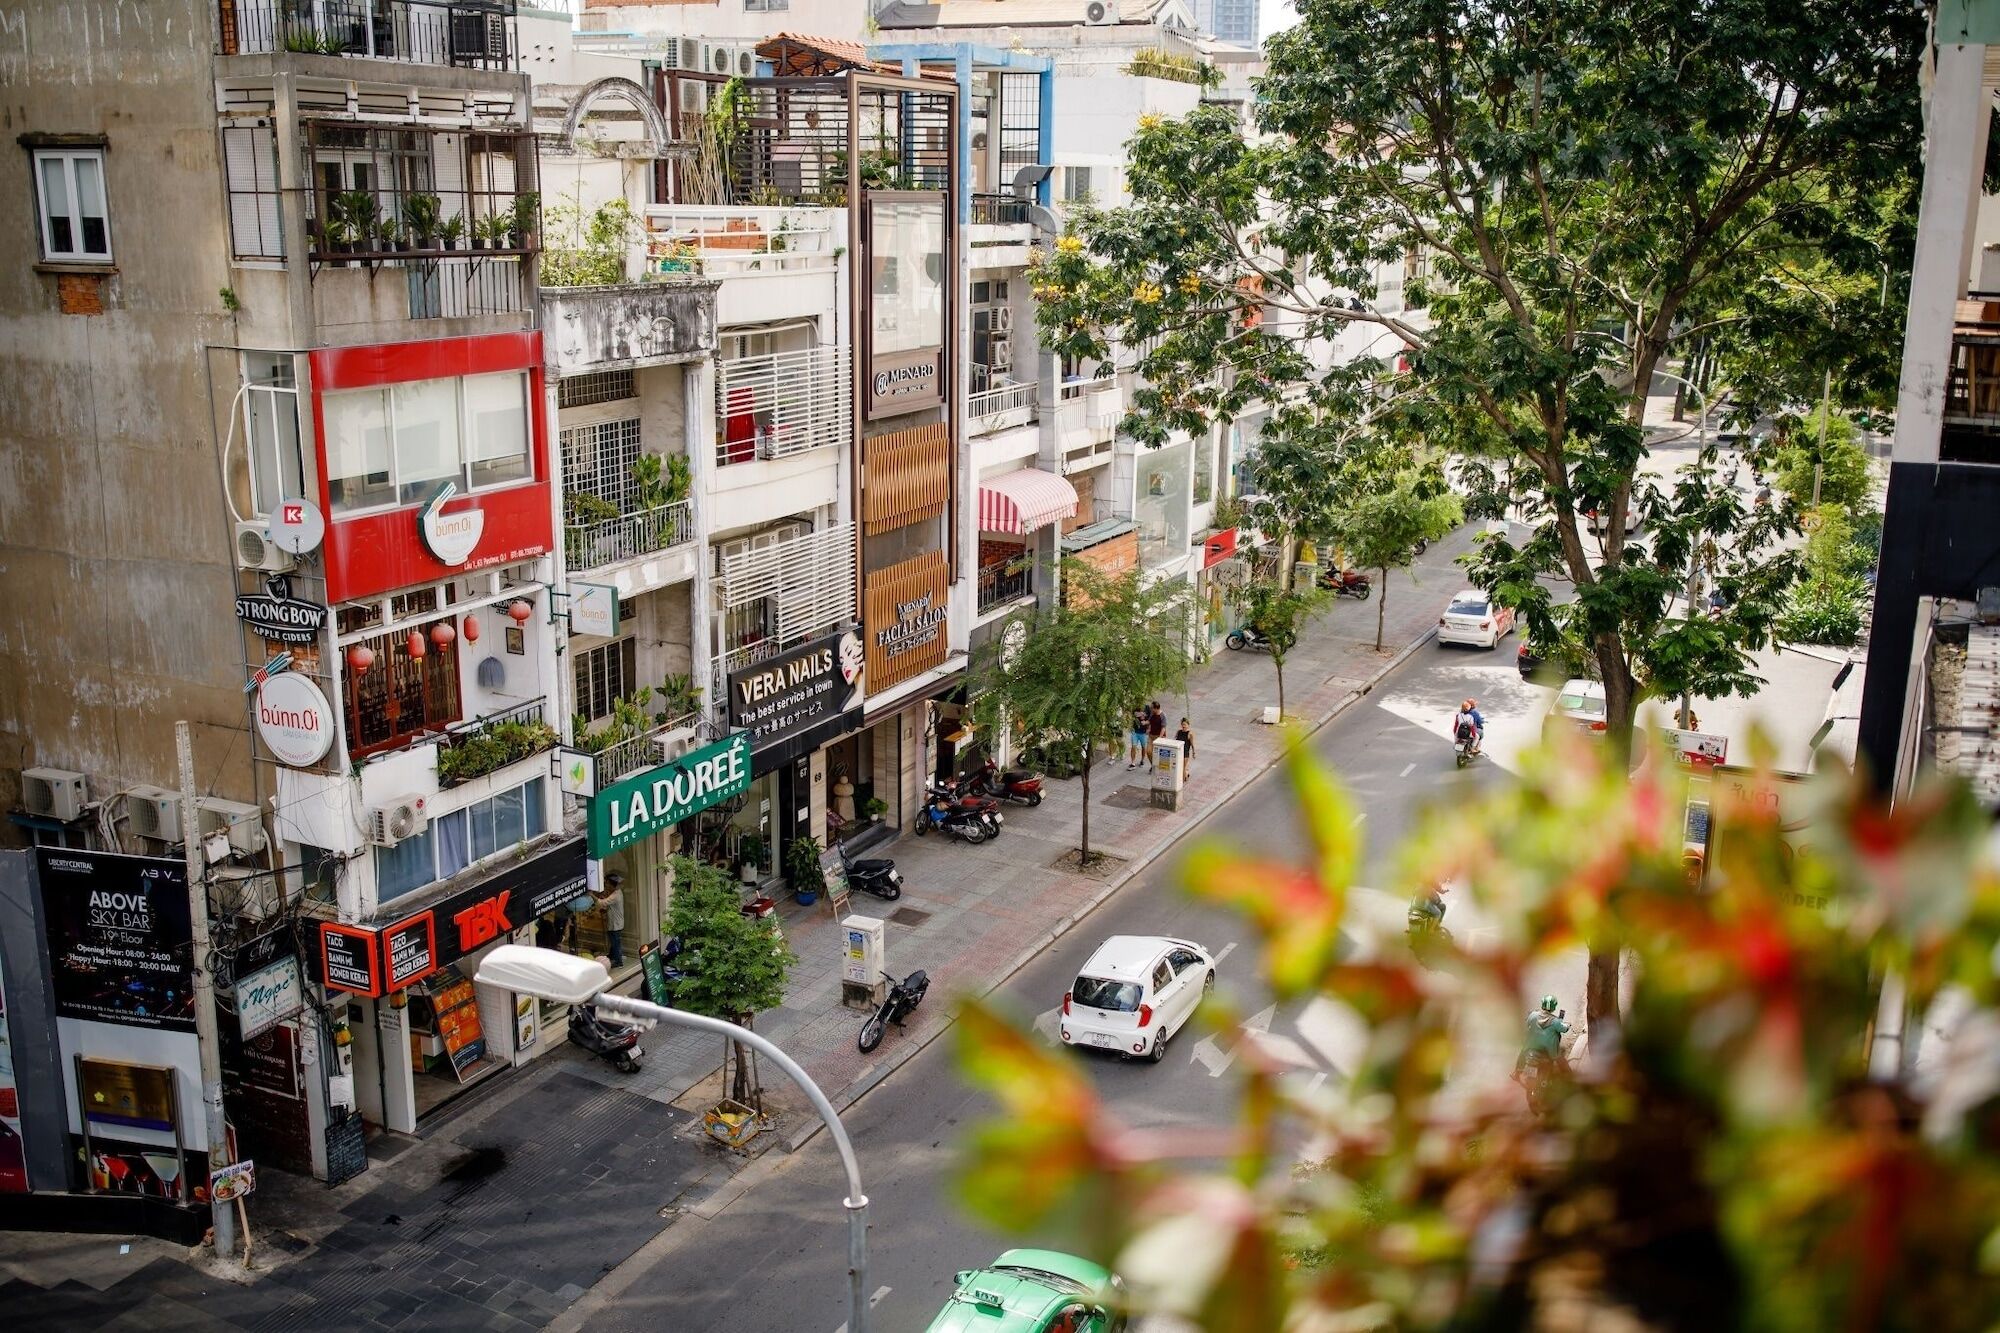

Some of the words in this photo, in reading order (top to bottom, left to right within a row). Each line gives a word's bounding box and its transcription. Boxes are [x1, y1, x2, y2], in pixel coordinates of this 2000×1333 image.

[889, 364, 935, 384] MENARD
[235, 600, 323, 628] STRONGBOW
[899, 596, 929, 614] MENARD
[253, 626, 280, 639] APPLE
[282, 629, 312, 642] CIDERS
[877, 619, 914, 647] FACIAL
[915, 605, 948, 631] SALON
[740, 668, 786, 705] VERA
[787, 648, 833, 687] NAILS
[740, 711, 756, 726] The
[757, 701, 776, 719] best
[776, 691, 806, 711] service
[806, 686, 814, 696] in
[815, 679, 833, 694] town
[610, 791, 650, 837] LA
[652, 736, 745, 818] DOREÉ
[610, 831, 637, 849] Fine
[651, 805, 693, 829] Baking
[702, 797, 708, 805] &
[717, 780, 743, 798] Food
[69, 860, 94, 871] CENTRAL
[89, 890, 148, 912] ABOVE
[535, 893, 555, 909] HOTLINE:
[91, 909, 117, 925] SKY
[122, 912, 150, 929] BAR
[453, 889, 513, 952] TBK
[121, 932, 144, 945] Floor
[326, 935, 344, 948] TACO
[390, 935, 407, 950] TACO
[77, 944, 105, 956] Opening
[106, 947, 124, 956] Hour:
[125, 949, 145, 959] 08:00
[151, 952, 171, 961] 24:00
[328, 952, 345, 964] BANH
[391, 949, 408, 965] BANH
[408, 945, 416, 957] MI
[69, 953, 92, 964] Happy
[92, 956, 112, 965] Hour:
[113, 959, 133, 968] 18:00
[139, 961, 160, 970] 20:00
[160, 963, 181, 973] DAILY
[392, 962, 412, 979] DONER
[412, 953, 430, 970] KEBAB
[329, 966, 350, 980] DONER
[350, 971, 370, 984] KEBAB
